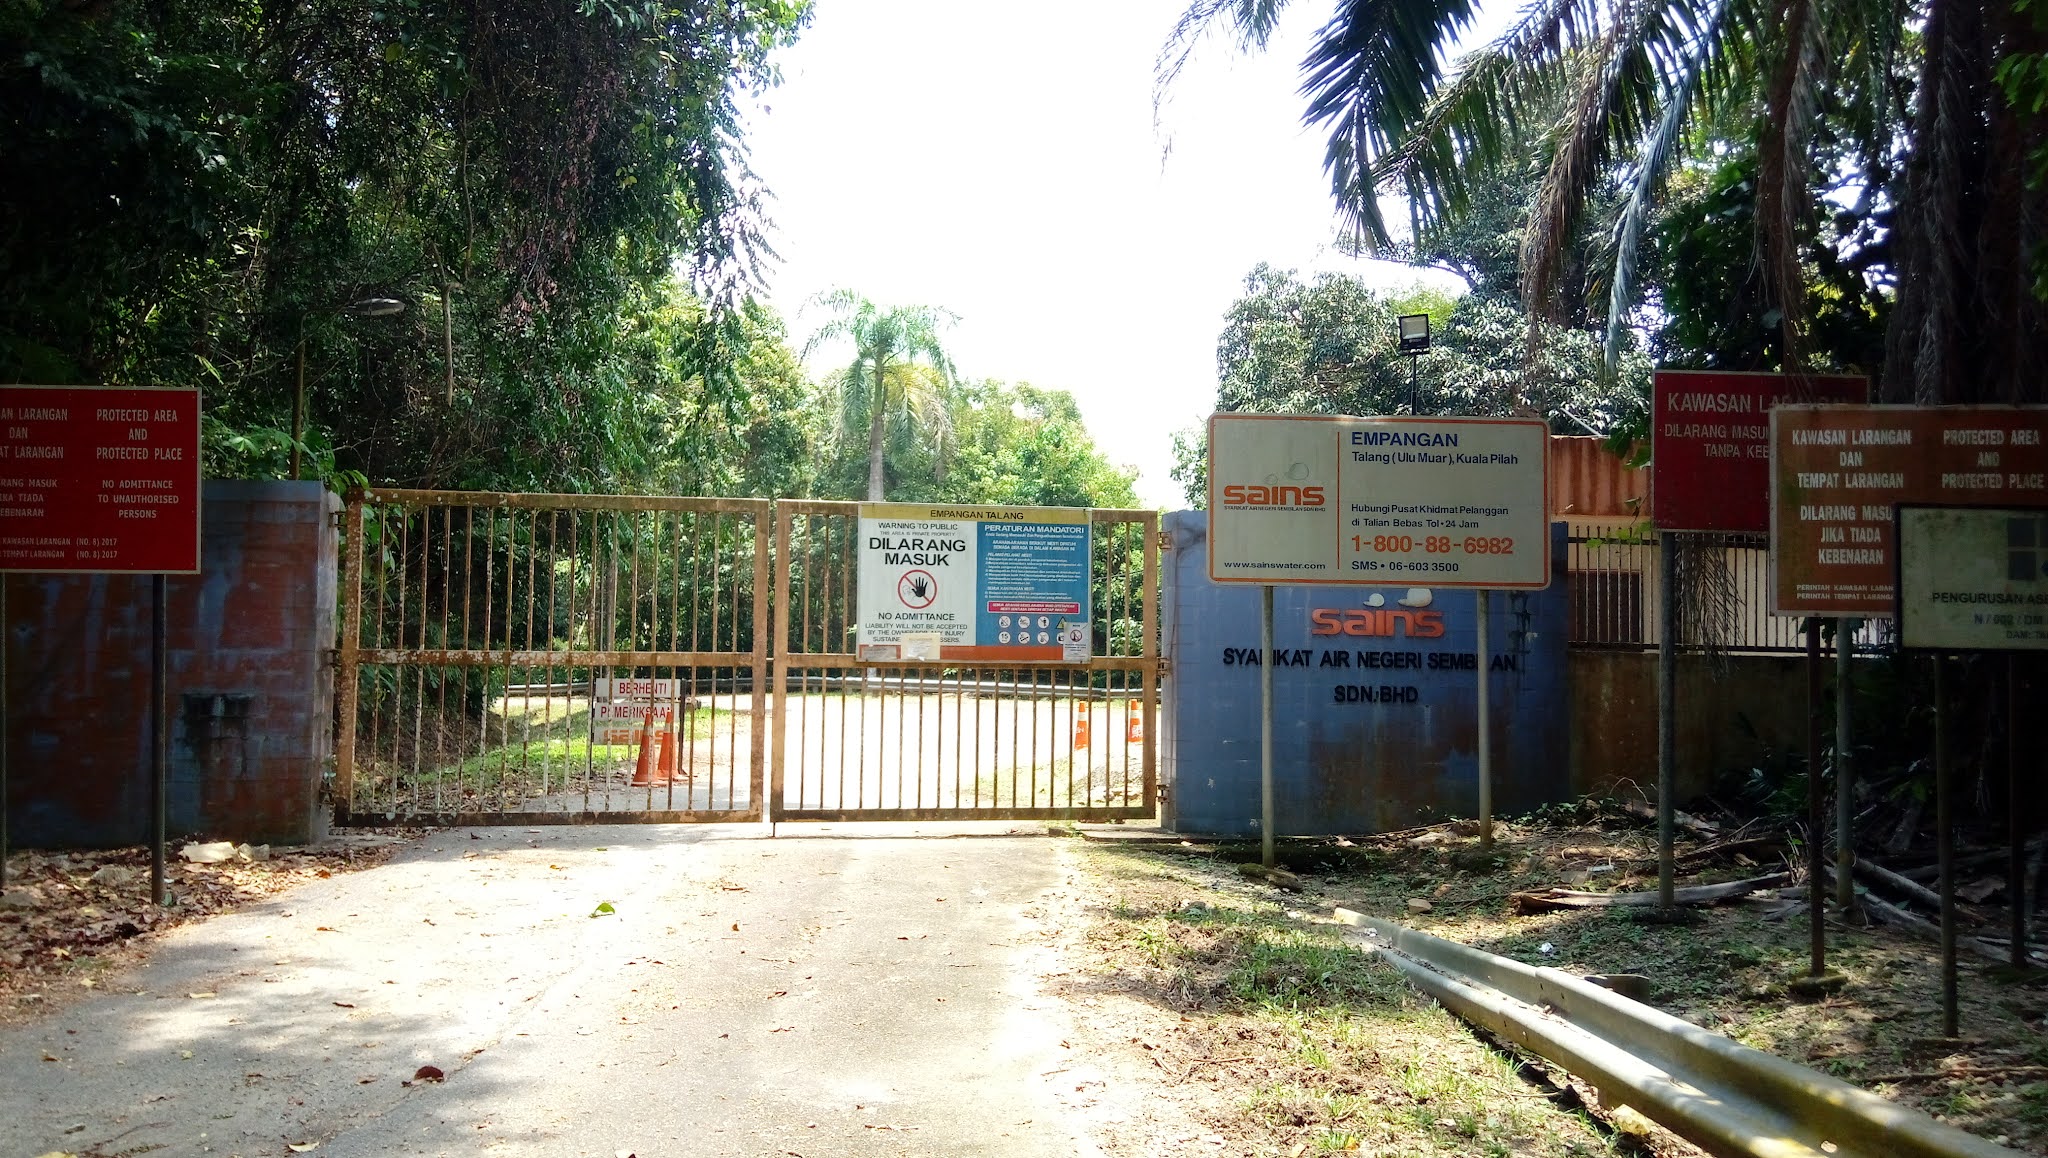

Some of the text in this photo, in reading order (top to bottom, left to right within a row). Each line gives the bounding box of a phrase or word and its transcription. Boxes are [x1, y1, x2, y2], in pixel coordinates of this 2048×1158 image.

[1668, 393, 1750, 412] KAWASAN
[19, 408, 68, 420] LARANGAN
[96, 409, 178, 422] PROTECTED AREA
[9, 427, 28, 439] DAN
[128, 428, 148, 440] AND
[1665, 424, 1769, 439] DILARANG MASU
[1792, 430, 1912, 445] KAWASAN LARANGAN
[1943, 430, 2040, 445] PROTECTED AREA
[1351, 432, 1458, 447] EMPANGAN
[15, 446, 64, 459] LARANGAN
[96, 447, 183, 460] PROTECTED PLACE
[1704, 443, 1740, 457] TANPA
[1352, 452, 1390, 464] Talang
[1456, 454, 1489, 464] Kuala
[1490, 454, 1518, 465] Pilah
[1840, 452, 1862, 466] DAN
[1977, 452, 2000, 467] AND
[28, 479, 58, 488] MASUK
[102, 480, 173, 489] NO ADMITTANCE
[1797, 473, 1904, 488] TEMPAT LARANGAN
[1941, 473, 2045, 489] PROTECTED PLACE
[19, 494, 44, 502] TIADA
[97, 494, 180, 504] TO UNAUTHORISED
[1224, 486, 1325, 506] sains
[118, 510, 157, 519] PERSONS
[930, 509, 1024, 520] EMPANGAN TALANG
[1351, 503, 1509, 516] Hubungi Pusat Khidmat Pelanggan
[1800, 505, 1856, 520] DILARANG
[1351, 518, 1360, 527] di
[1364, 519, 1390, 527] Talian
[1393, 519, 1423, 527] Bebas
[1459, 520, 1479, 528] Jam
[1821, 527, 1881, 542] JIKA TIADA
[2, 537, 34, 545] KAWASAN
[36, 537, 71, 546] LARANGAN
[76, 537, 91, 546] (NO.
[101, 538, 118, 546] 2017
[869, 537, 966, 552] DILARANG
[3, 550, 28, 558] TEMPAT
[30, 550, 65, 558] LARANGAN
[101, 551, 118, 559] 2017
[884, 553, 950, 566] MASUK
[1818, 548, 1884, 564] KEBENARAN
[1224, 562, 1326, 570] www.sainswater.com
[1351, 561, 1459, 572] SMS 06-603 3500
[1931, 592, 2023, 604] PENGURUSAN
[895, 613, 955, 621] ADMITTANCE
[1311, 608, 1446, 638] sains
[1223, 648, 1516, 671] SYAIKAT AIR NEGERI SEMBIAN
